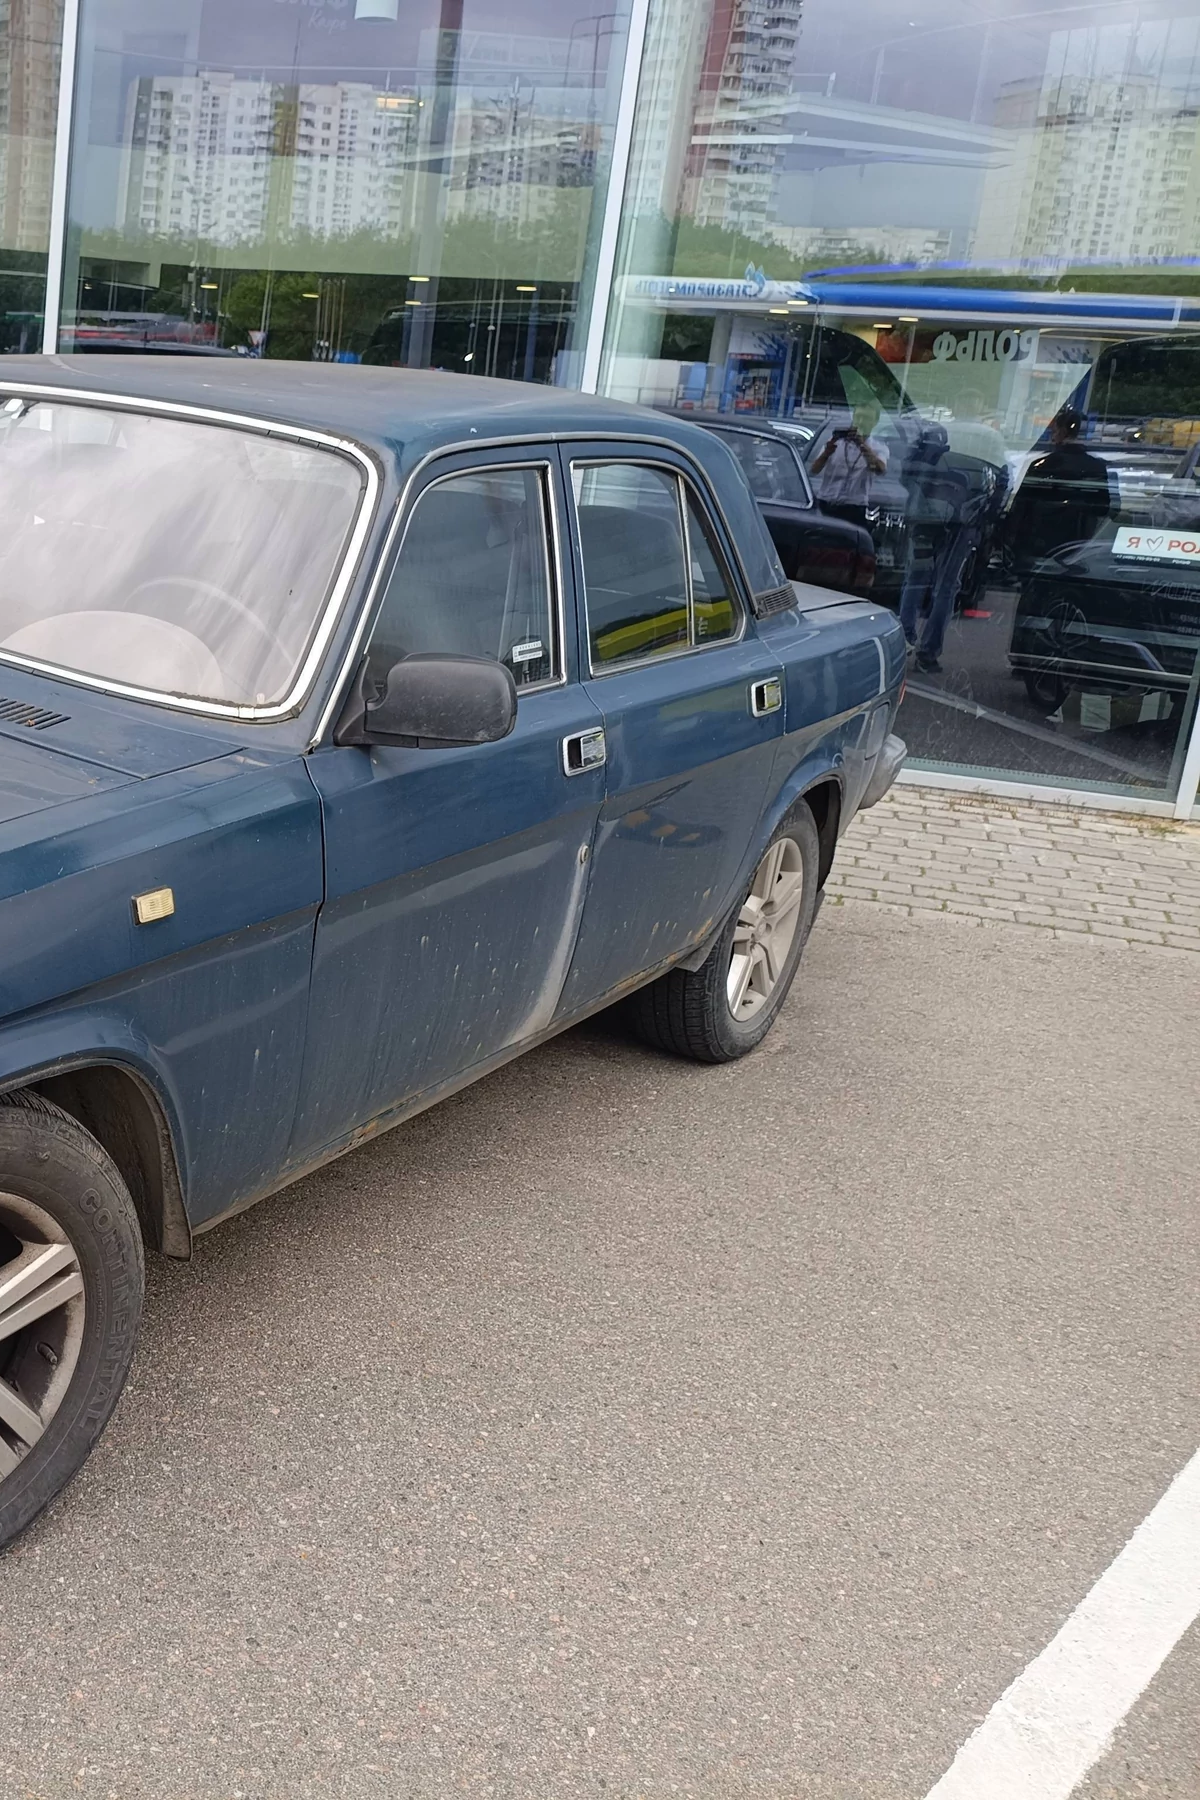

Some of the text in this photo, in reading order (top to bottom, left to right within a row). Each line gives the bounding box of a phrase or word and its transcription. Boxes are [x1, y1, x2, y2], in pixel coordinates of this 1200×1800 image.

[1127, 536, 1200, 553] Я РО
[79, 1187, 131, 1428] CONTINENTAL
